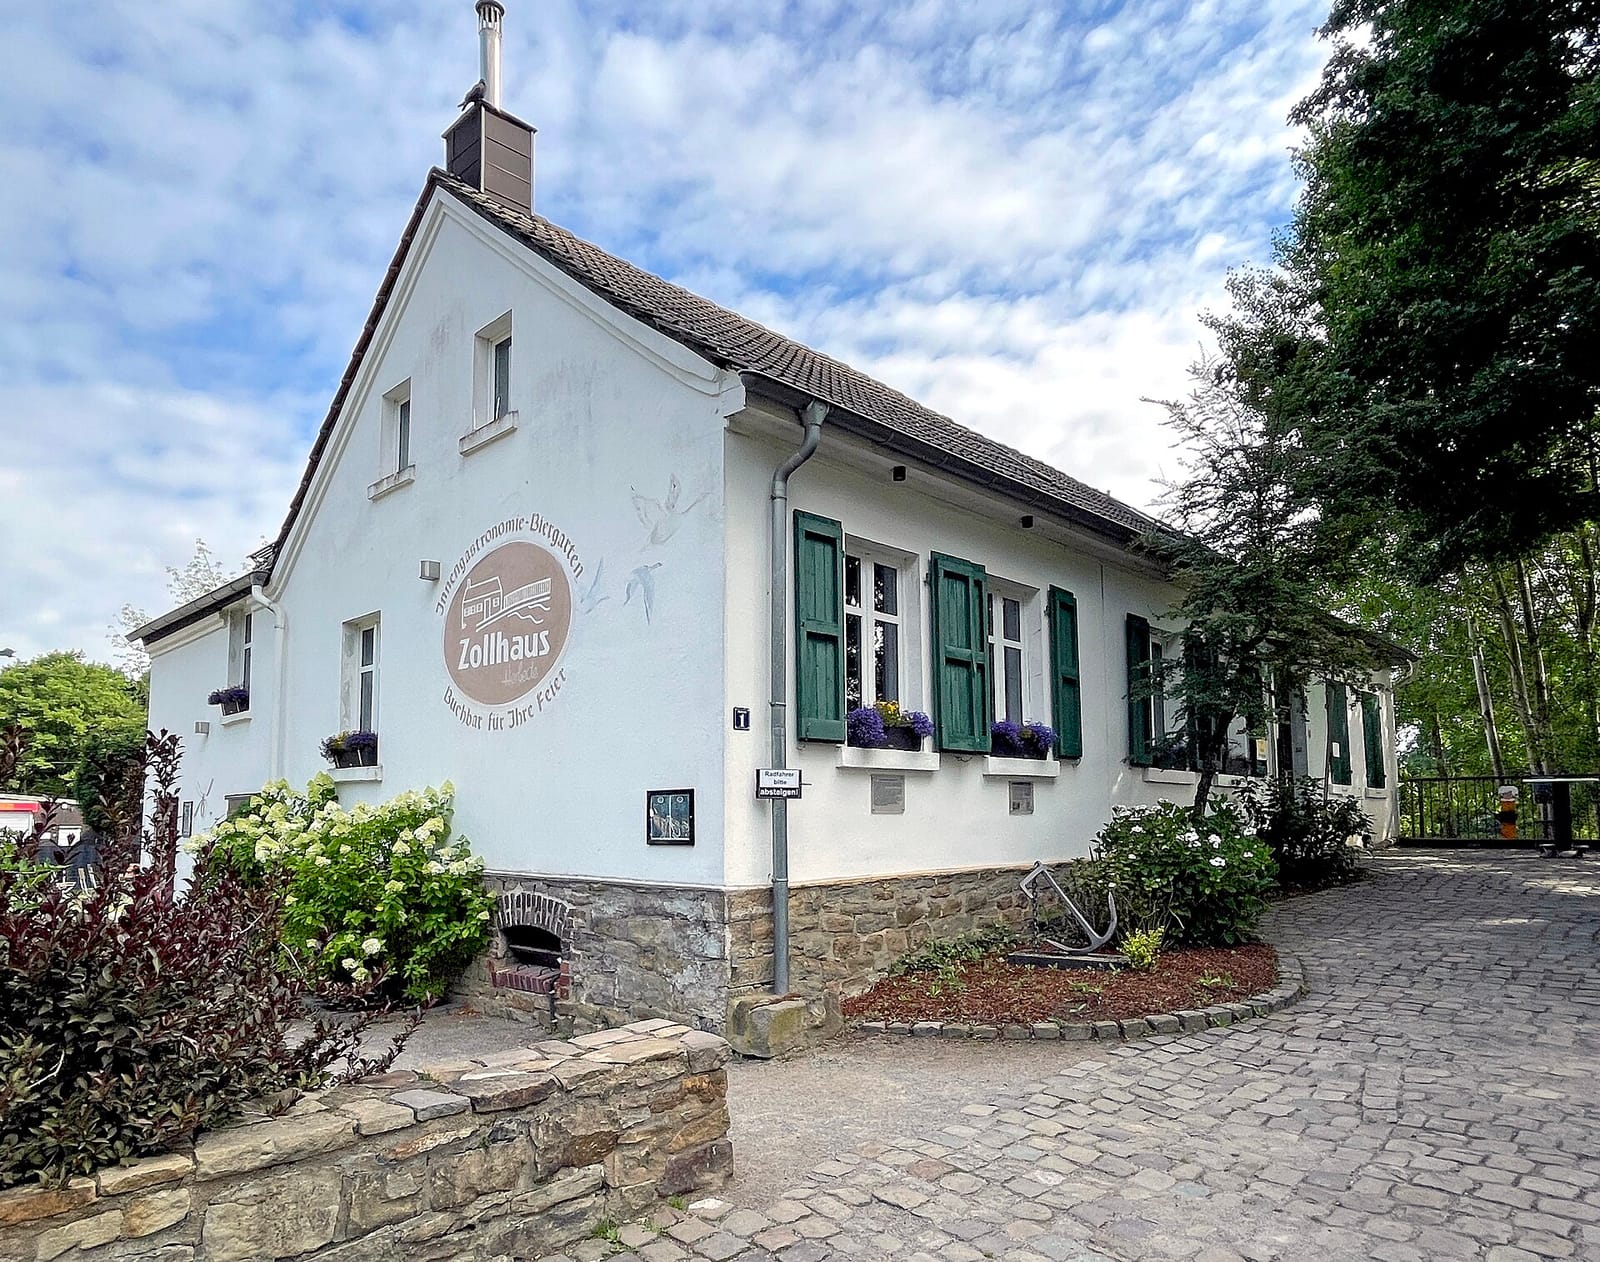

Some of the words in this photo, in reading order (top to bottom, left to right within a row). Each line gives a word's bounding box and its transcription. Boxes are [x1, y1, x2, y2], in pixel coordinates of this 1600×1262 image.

[458, 630, 550, 671] Zollhaus
[443, 686, 483, 730] Buchbar
[488, 711, 504, 731] für
[507, 705, 534, 729] Ihre
[536, 667, 567, 712] Feier
[738, 713, 745, 728] 1
[760, 788, 799, 797] absteigen!
